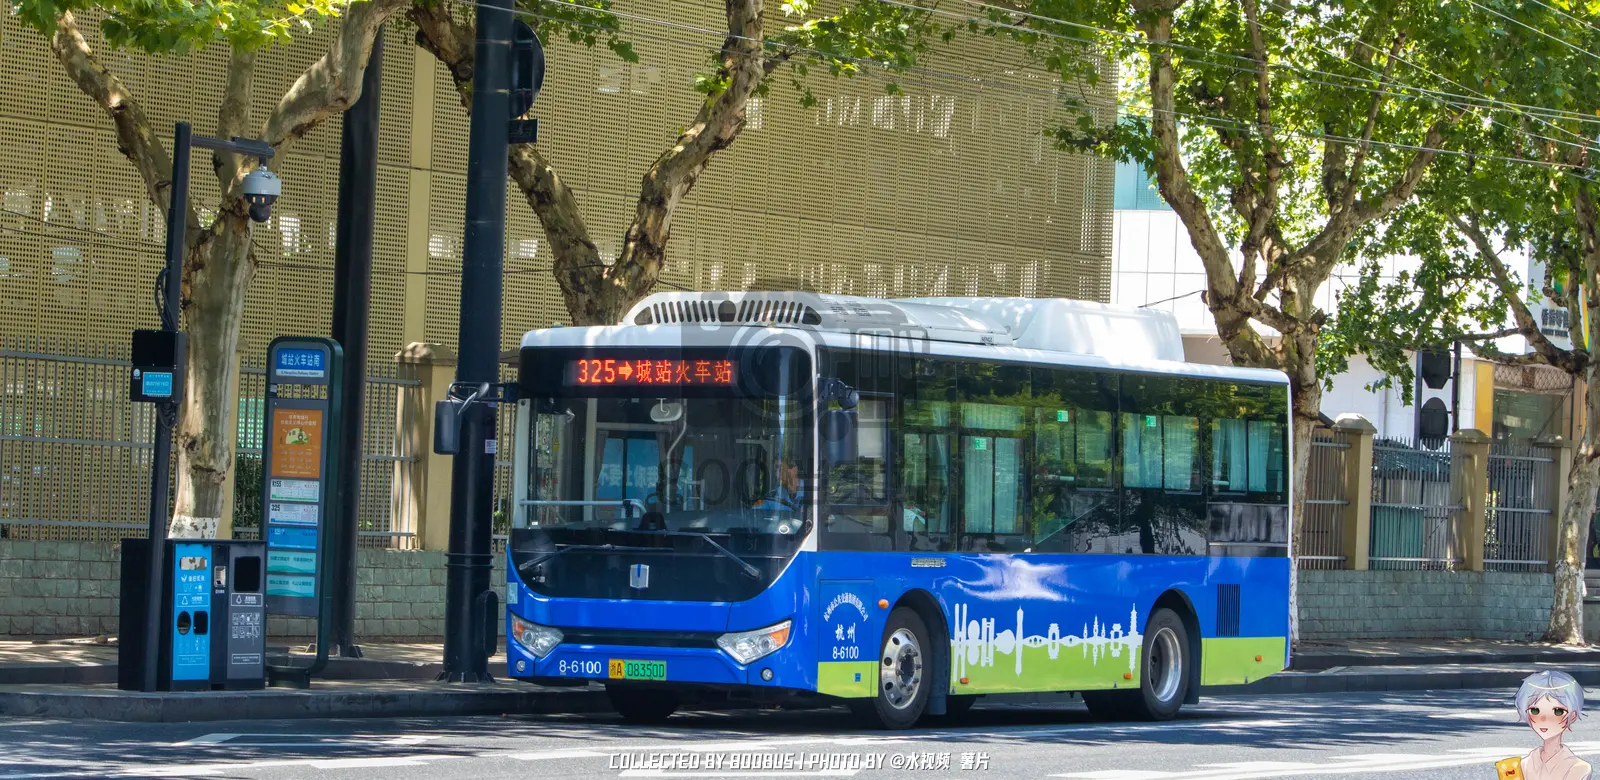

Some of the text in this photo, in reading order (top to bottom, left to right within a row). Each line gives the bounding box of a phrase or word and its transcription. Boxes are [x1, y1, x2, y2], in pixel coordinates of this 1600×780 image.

[281, 353, 320, 367] 城站火车站南
[578, 359, 732, 383] 325 城站火车站
[835, 622, 856, 643] 杭州
[832, 646, 859, 659] 8-6100
[559, 660, 601, 674] 8-6100
